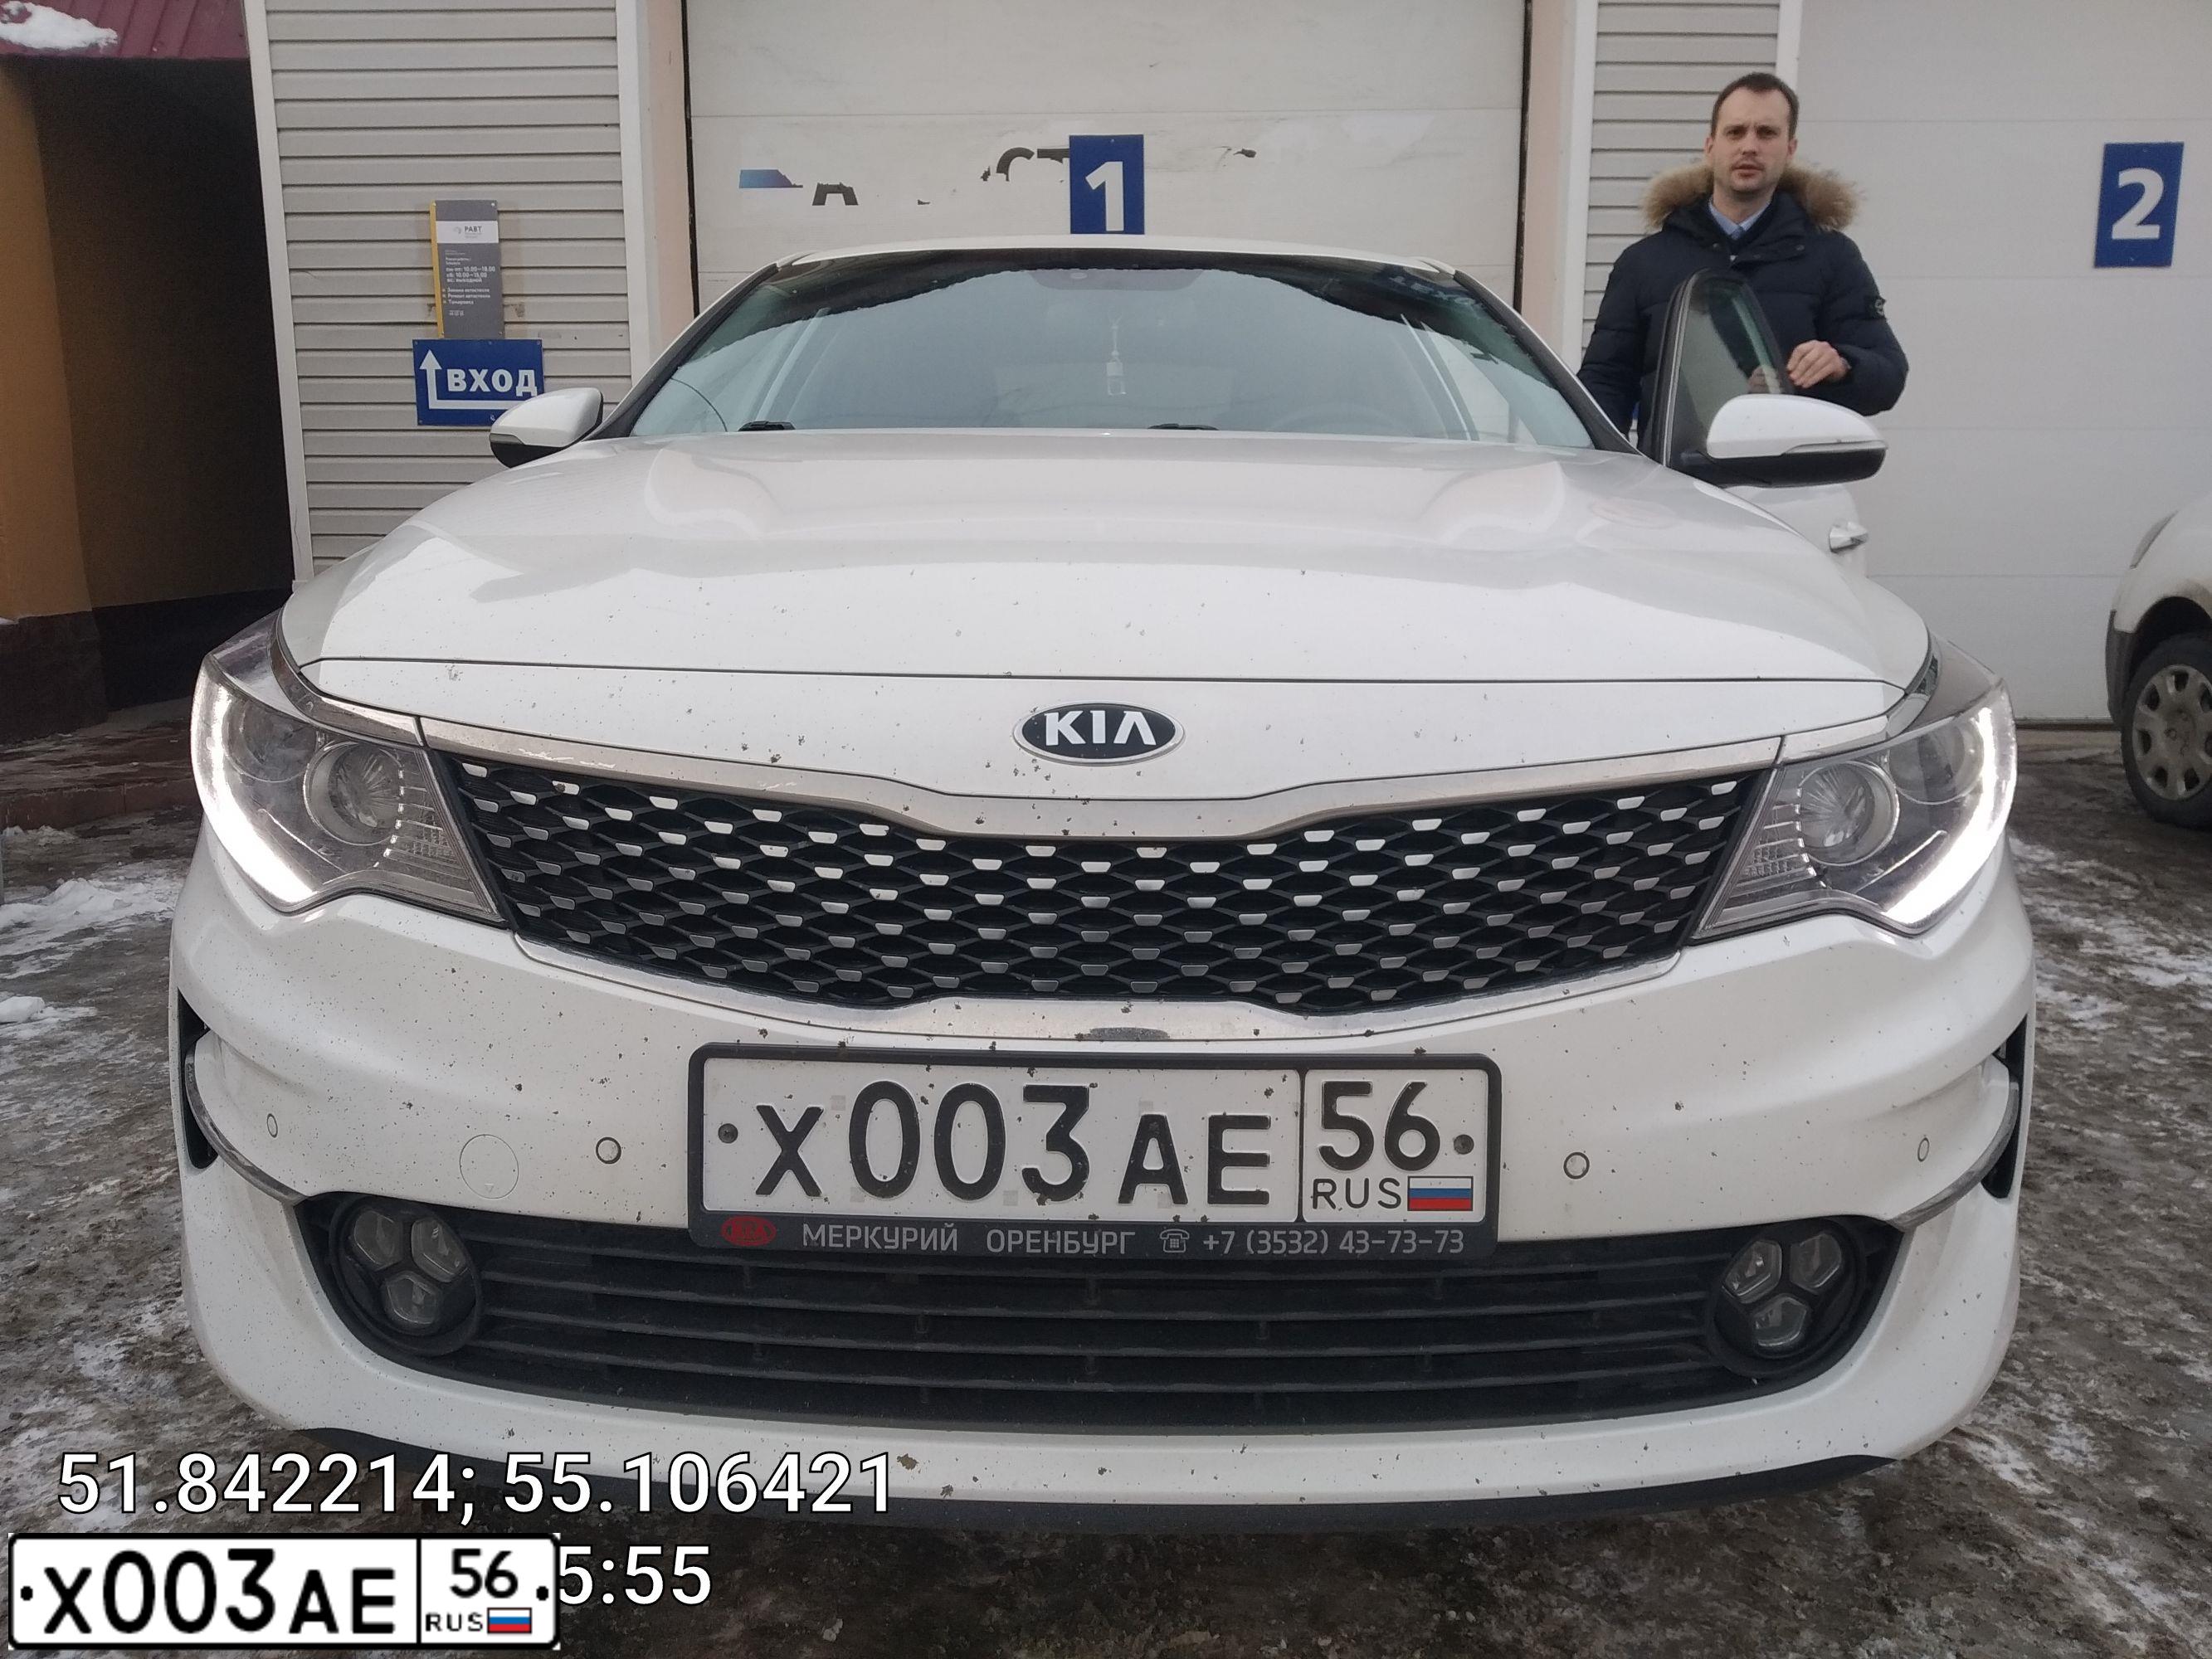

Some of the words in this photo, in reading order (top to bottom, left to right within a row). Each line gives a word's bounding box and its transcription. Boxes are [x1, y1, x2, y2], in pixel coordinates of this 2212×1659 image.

[1085, 161, 1125, 231] 1
[2111, 168, 2165, 241] 2
[446, 368, 538, 397] ВХОД
[1044, 710, 1157, 746] KIA
[1318, 1081, 1440, 1171] 56
[1310, 1177, 1402, 1209] RUS
[803, 1222, 957, 1252] МЕРКУРИЙ
[987, 1228, 1136, 1255] ОРЕНБУРГ
[1203, 1230, 1235, 1254] +7
[1246, 1229, 1328, 1255] (3532)
[1339, 1229, 1464, 1254] 43-73-73
